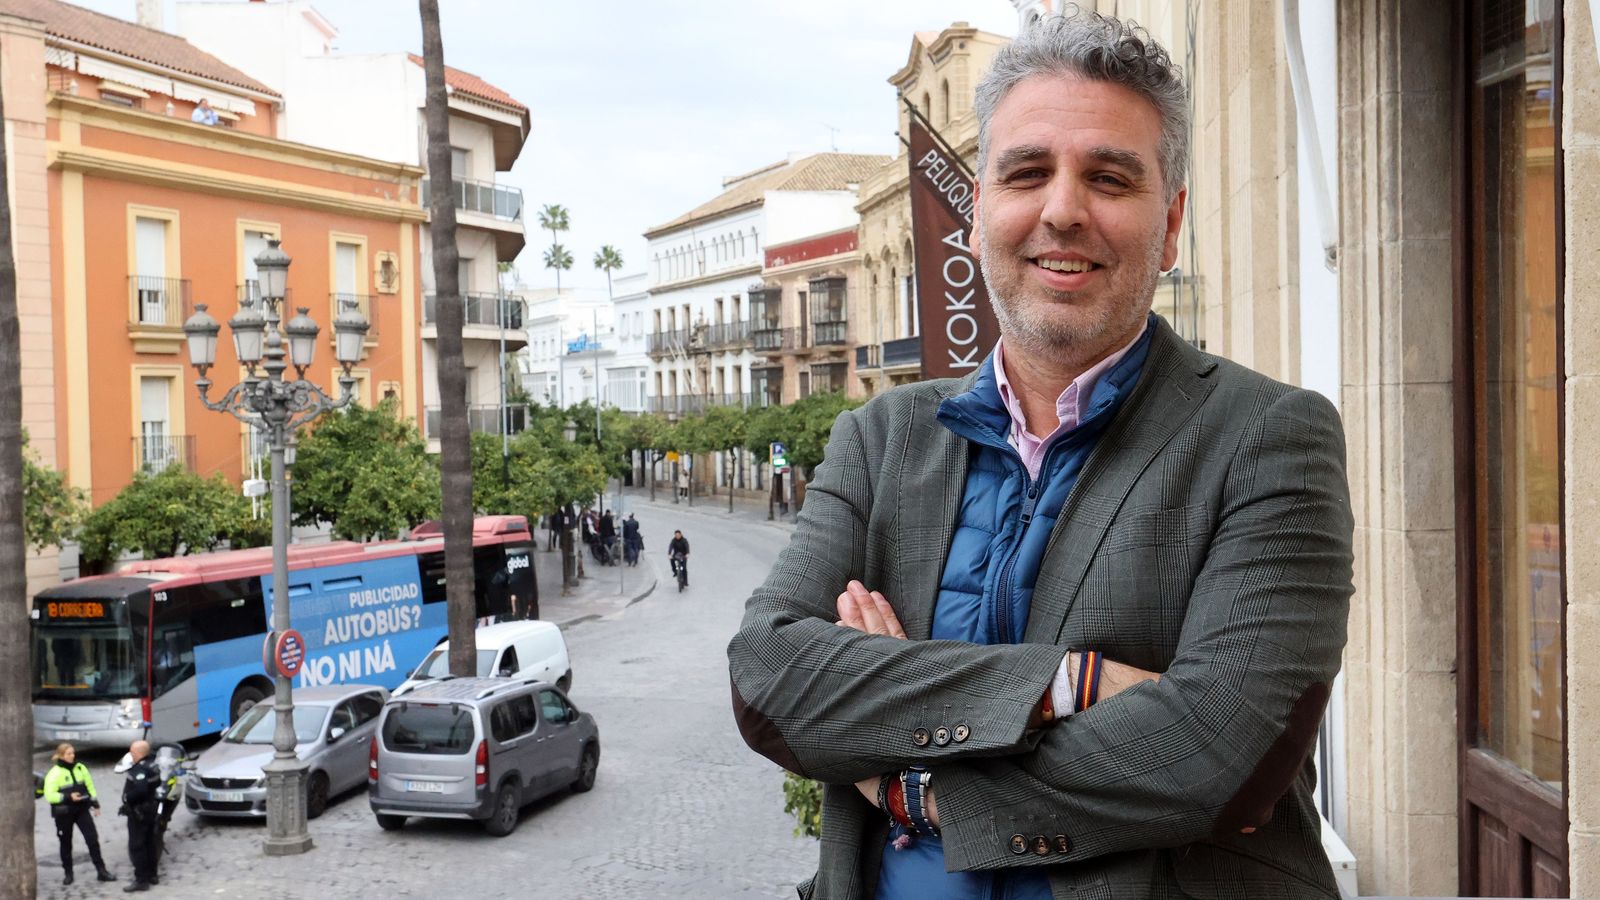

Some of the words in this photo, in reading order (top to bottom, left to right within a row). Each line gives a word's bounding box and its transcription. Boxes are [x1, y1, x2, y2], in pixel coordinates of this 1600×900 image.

[942, 228, 979, 368] KOKOA
[507, 554, 529, 574] global
[349, 583, 419, 609] PUBLICIDAD
[324, 604, 421, 646] AUTOBÚS?
[300, 656, 336, 688] NO
[338, 650, 362, 681] NI
[364, 639, 396, 676] NÁ
